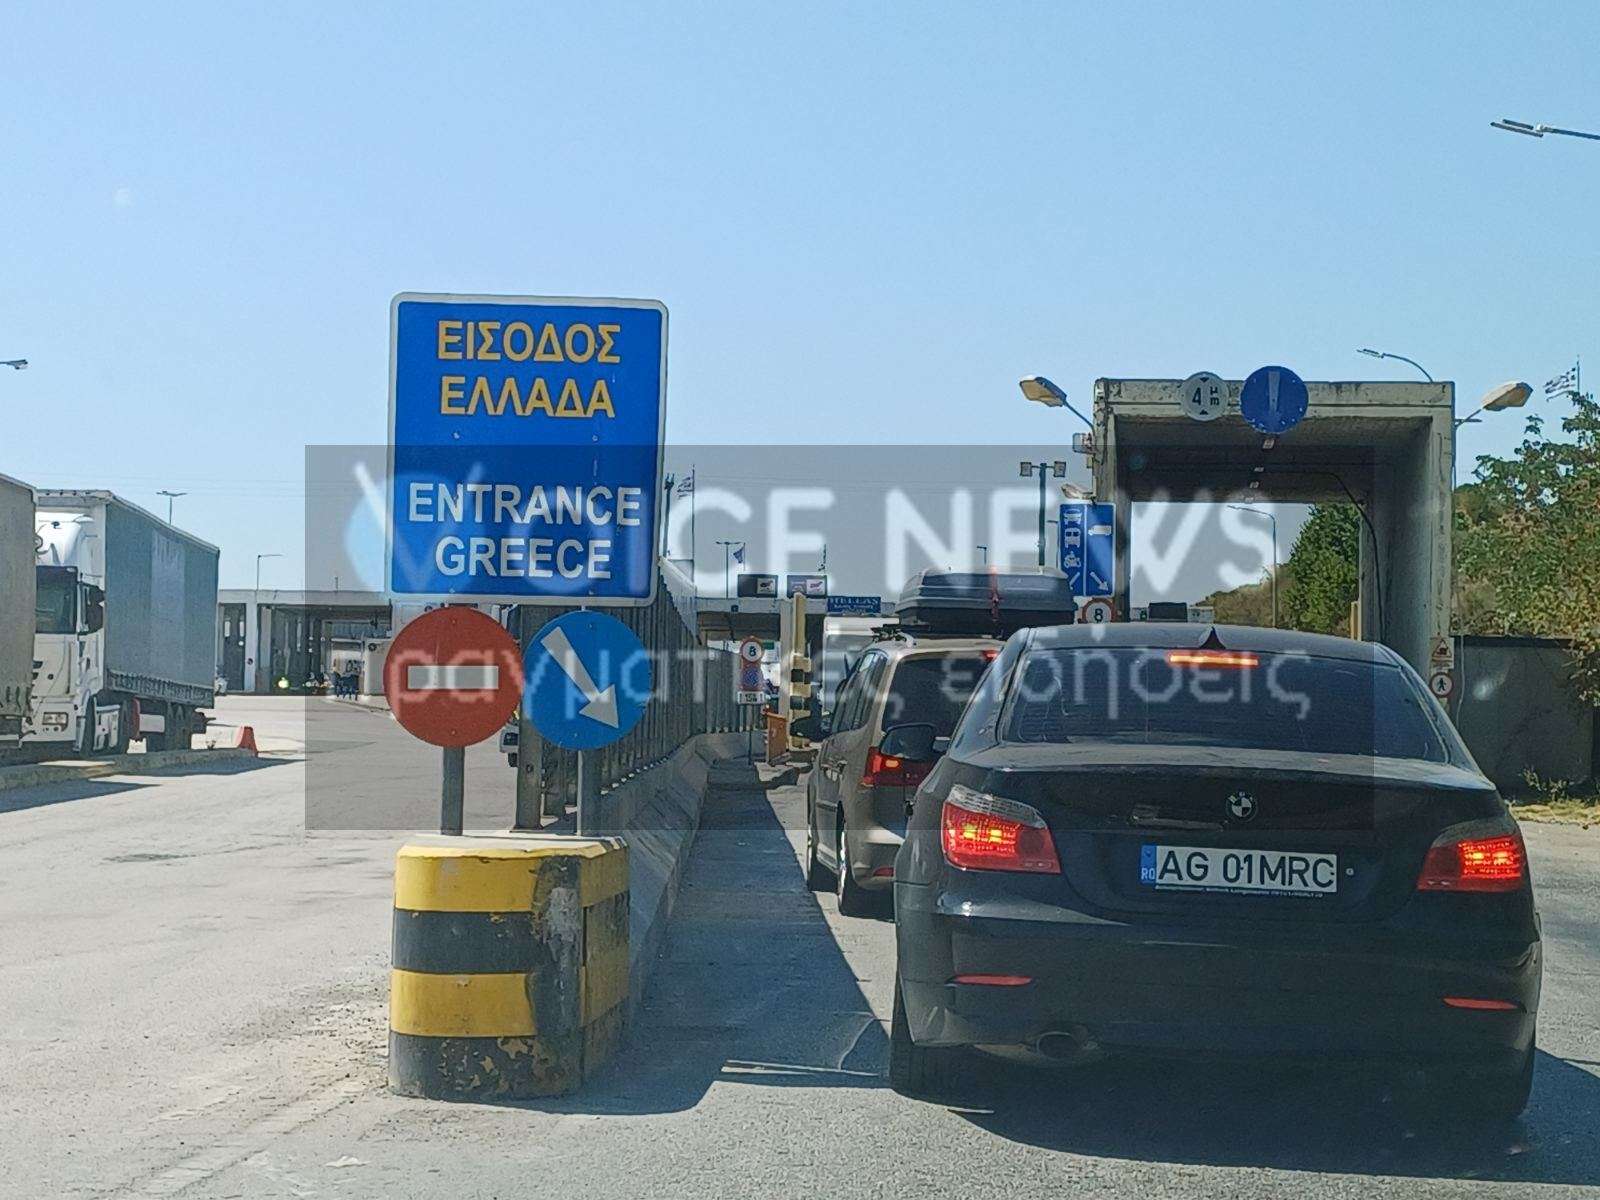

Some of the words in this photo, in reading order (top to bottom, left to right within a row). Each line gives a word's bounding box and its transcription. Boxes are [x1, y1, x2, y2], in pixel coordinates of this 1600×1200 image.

[437, 320, 621, 363] ΕΙΣΟΔΟΣ
[440, 376, 616, 418] ΕΛΛΑΔΑ
[1192, 387, 1201, 406] 4
[408, 482, 642, 526] ENTRANCE
[435, 536, 612, 579] GREECE
[1141, 867, 1156, 881] RO
[1158, 850, 1209, 881] AG
